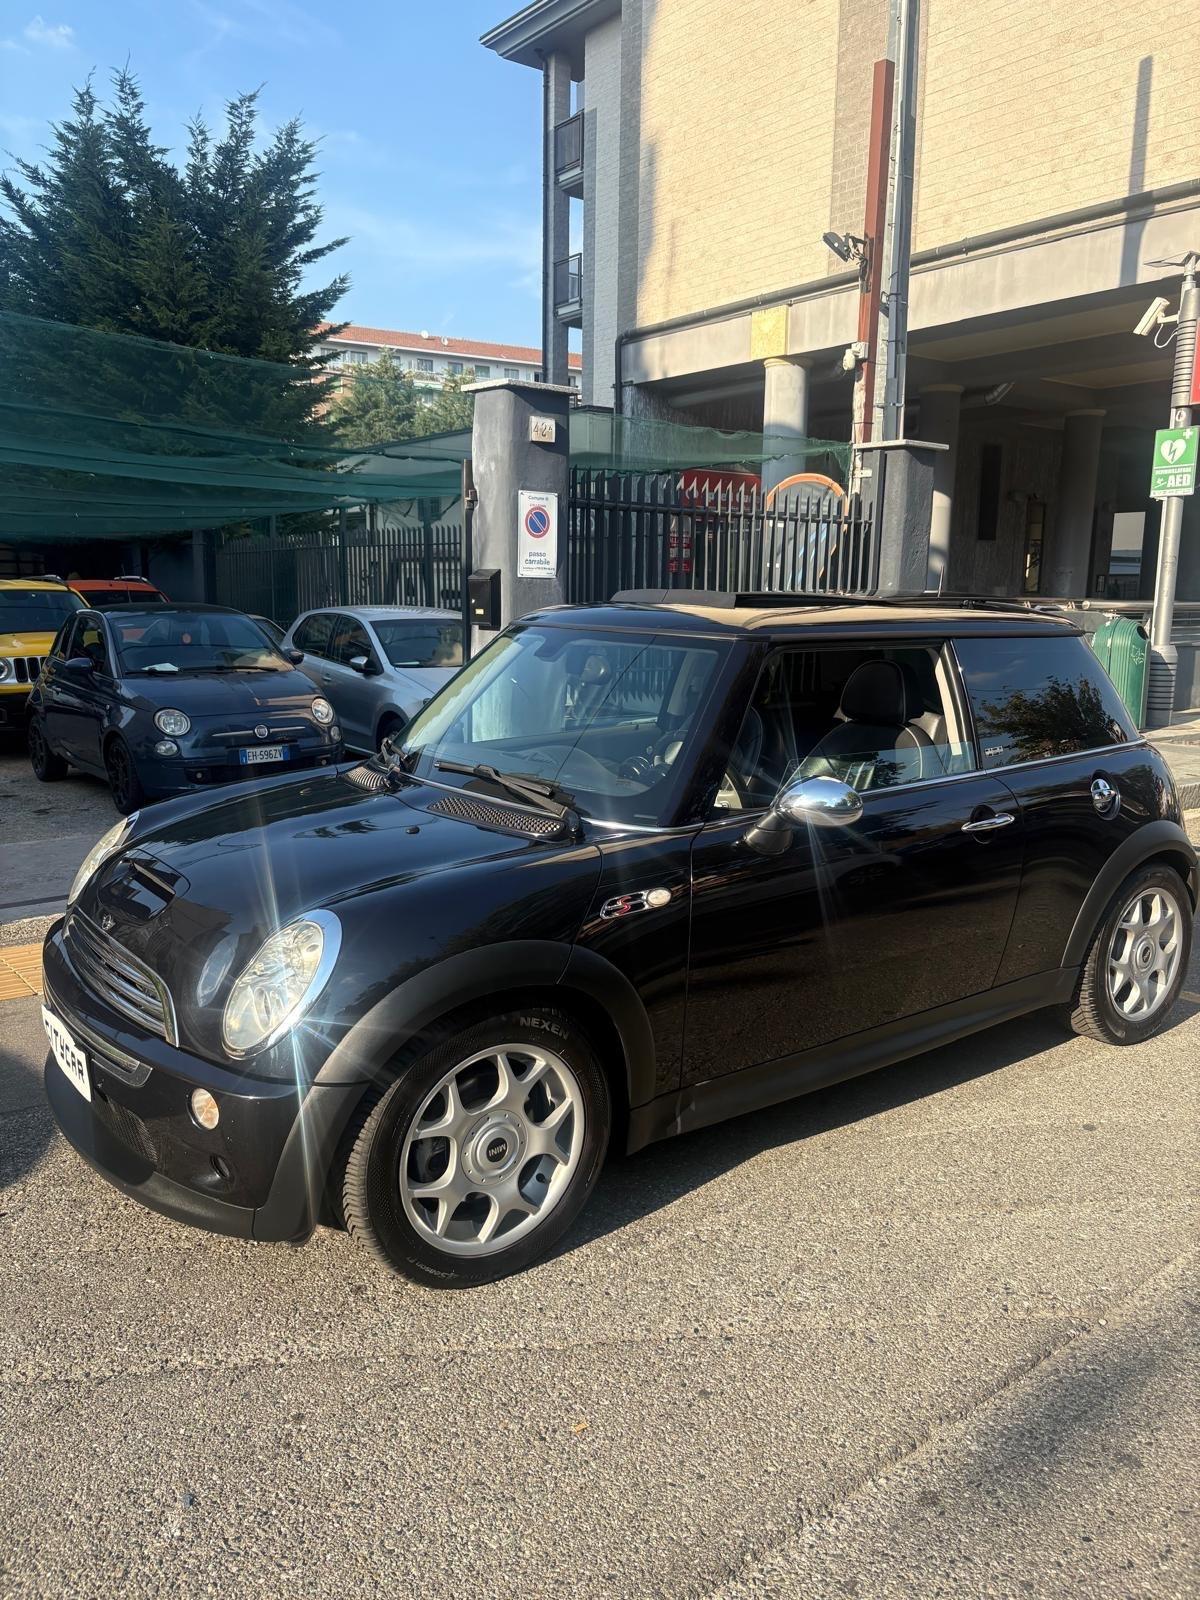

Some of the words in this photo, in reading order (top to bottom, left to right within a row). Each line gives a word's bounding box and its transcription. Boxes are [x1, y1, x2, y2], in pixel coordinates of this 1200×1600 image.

[1167, 474, 1191, 487] AED
[525, 558, 551, 566] carrabile
[520, 1016, 570, 1040] NEXEN
[488, 1143, 507, 1157] MINI
